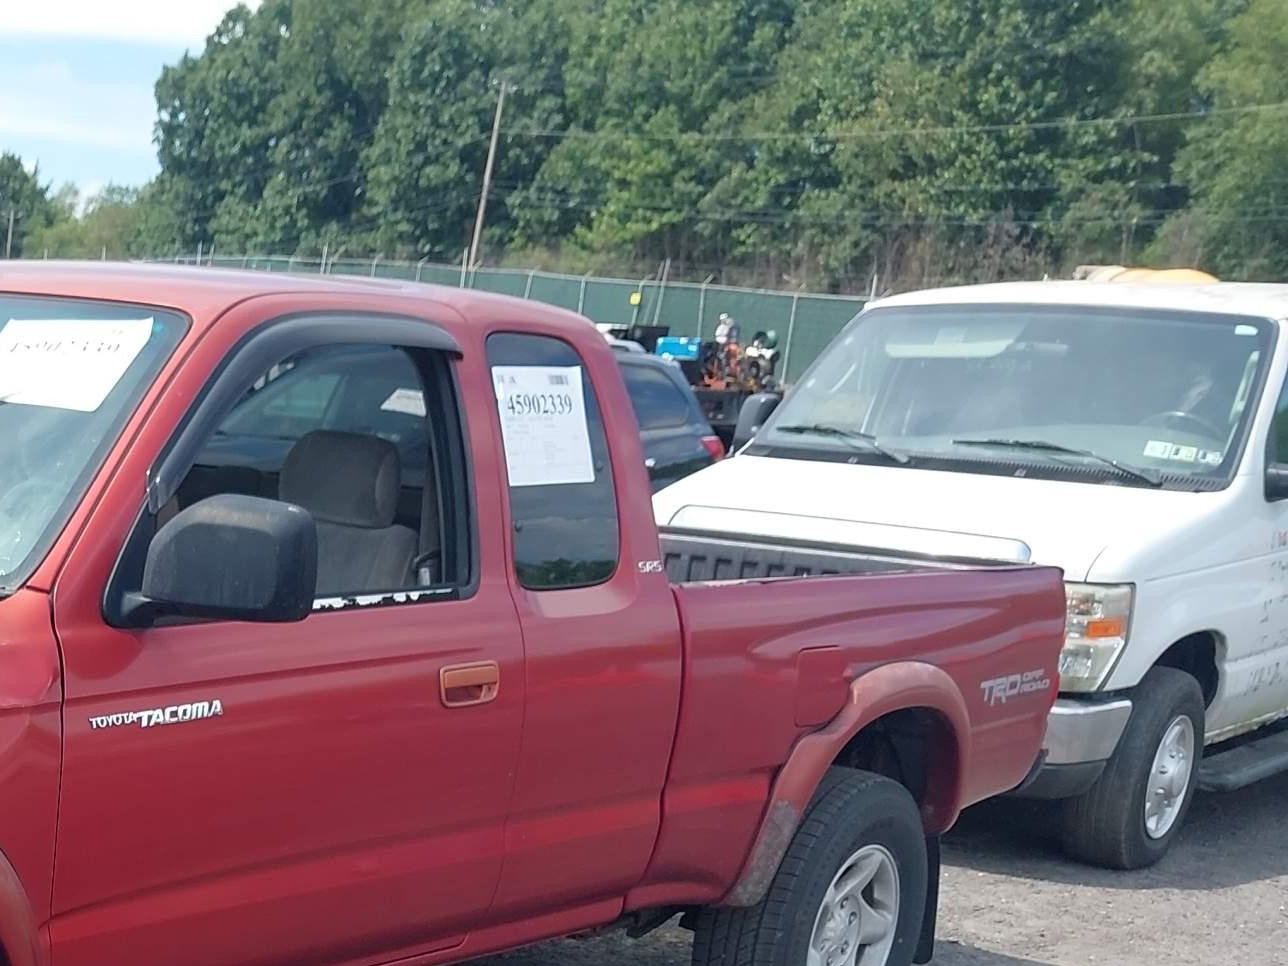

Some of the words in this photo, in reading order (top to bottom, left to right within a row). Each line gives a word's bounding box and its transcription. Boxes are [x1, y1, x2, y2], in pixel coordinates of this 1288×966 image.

[506, 393, 573, 416] 45902339
[637, 560, 663, 574] SR5
[1022, 668, 1045, 682] OFF
[980, 673, 1022, 707] TRD
[1020, 679, 1051, 694] ROAD
[88, 711, 138, 730] TOYOTA
[134, 699, 225, 729] TACOMA
